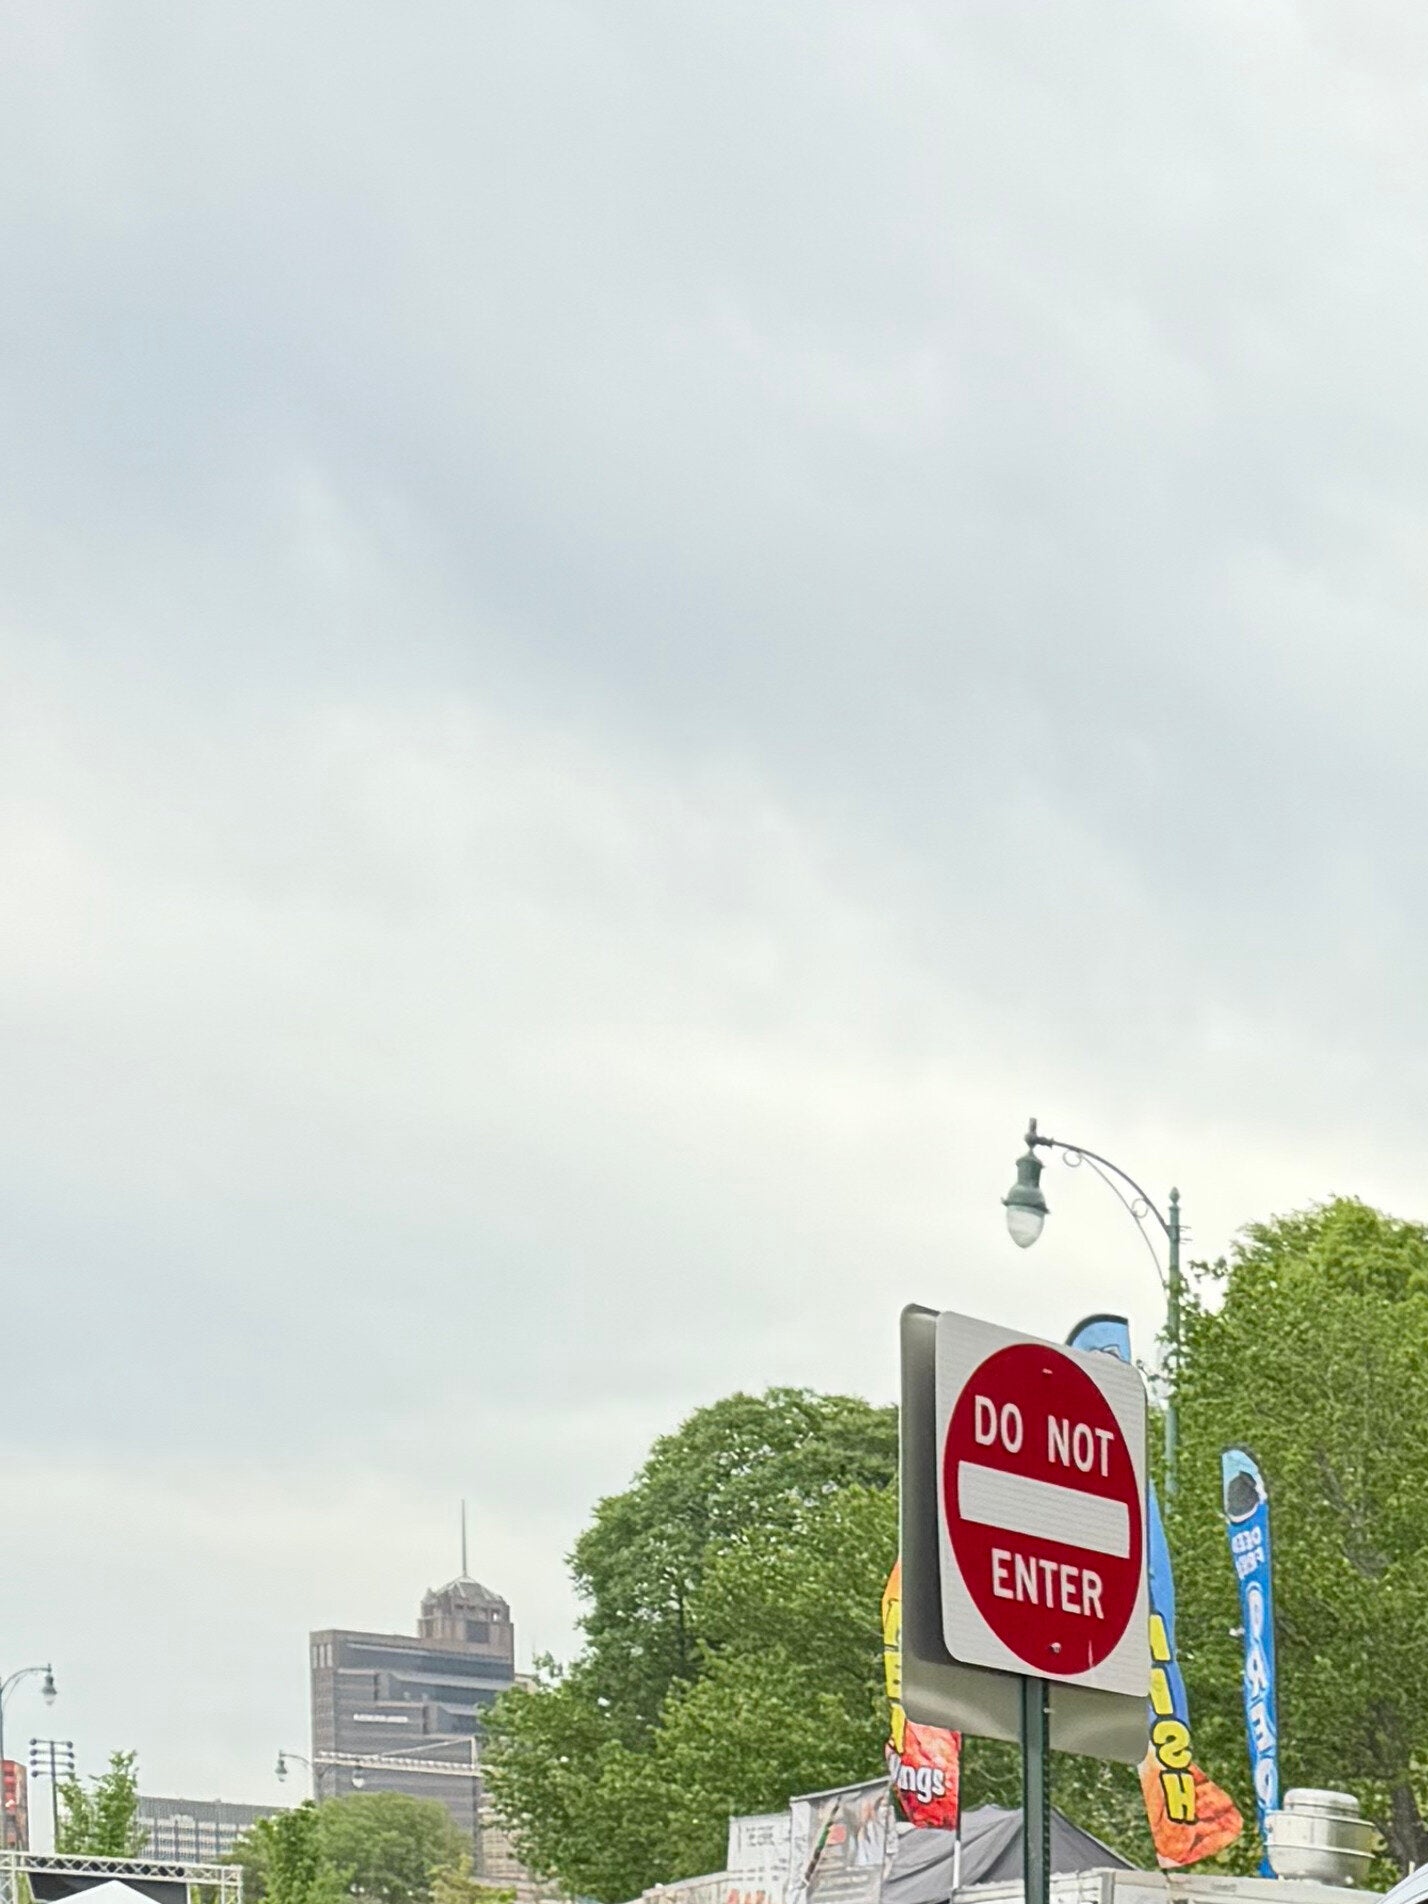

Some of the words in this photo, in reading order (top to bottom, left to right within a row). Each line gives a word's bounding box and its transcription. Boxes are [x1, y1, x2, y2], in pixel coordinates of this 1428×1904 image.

[975, 1395, 1024, 1454] DO
[1047, 1414, 1116, 1478] NOT
[991, 1547, 1105, 1620] ENTER
